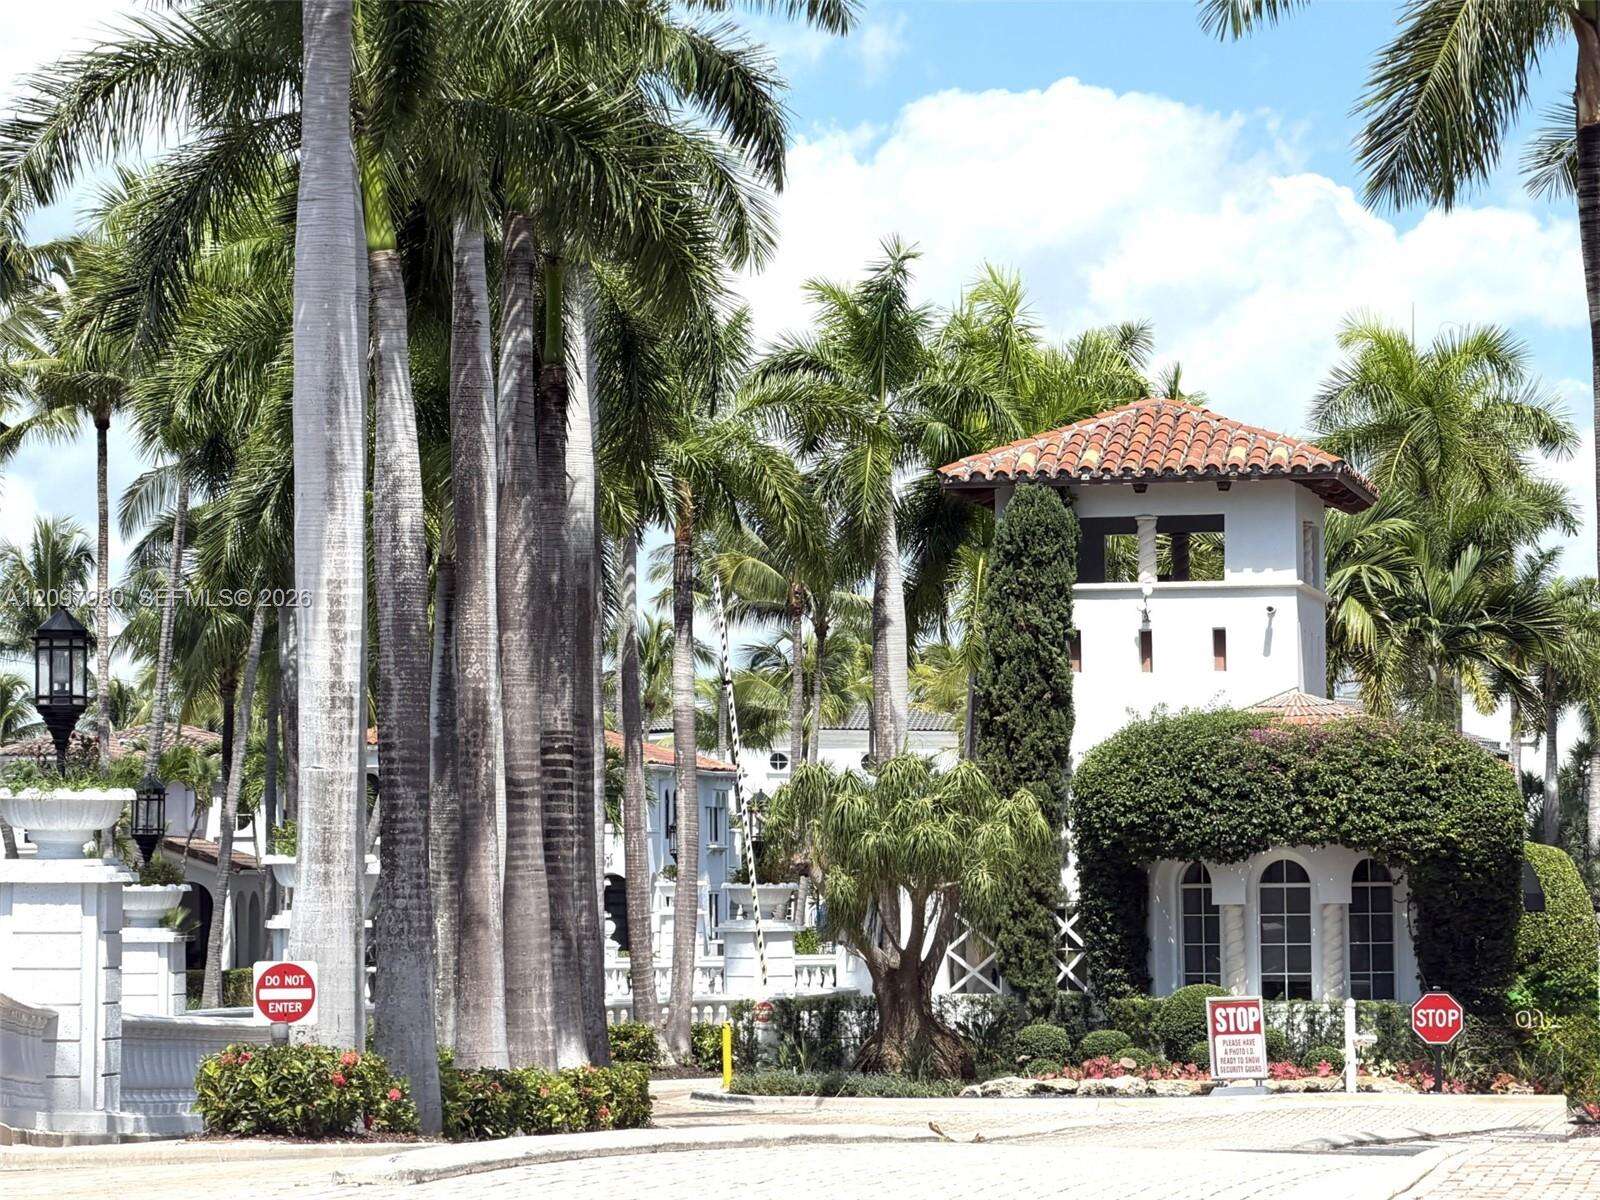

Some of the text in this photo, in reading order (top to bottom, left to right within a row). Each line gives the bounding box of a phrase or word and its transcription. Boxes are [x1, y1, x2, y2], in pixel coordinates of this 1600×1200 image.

[265, 974, 305, 986] DO NOT
[268, 1002, 302, 1013] ENTER
[1214, 1006, 1260, 1032] STOP
[1416, 1008, 1459, 1028] STOP
[1222, 1038, 1255, 1047] PLEASE HAVE
[1229, 1047, 1246, 1056] PHOTO
[1220, 1057, 1237, 1065] READY
[1245, 1065, 1262, 1073] GUARD
